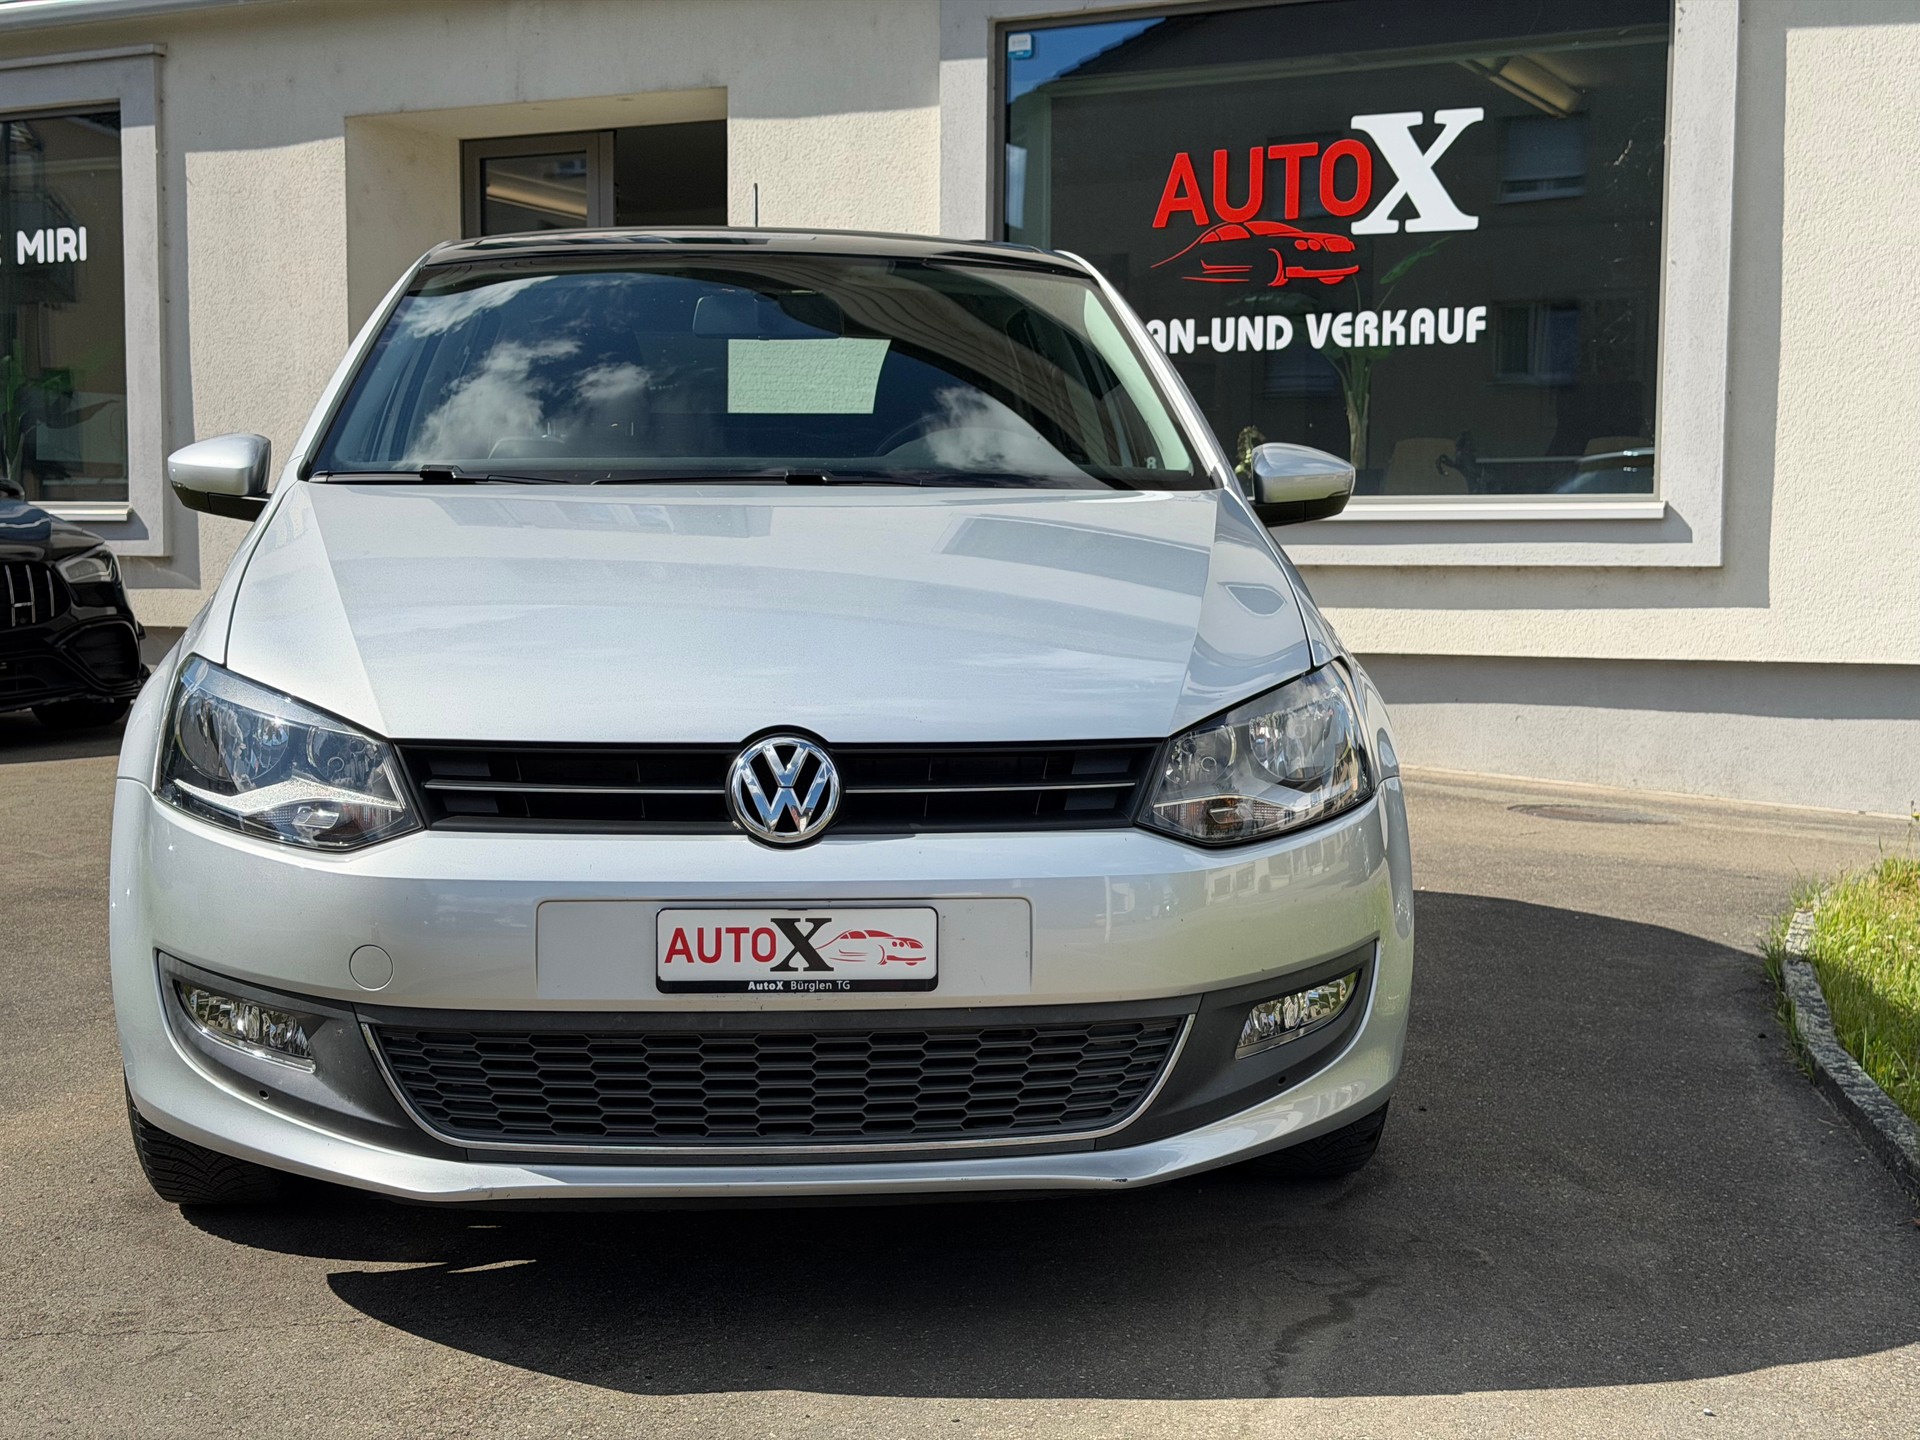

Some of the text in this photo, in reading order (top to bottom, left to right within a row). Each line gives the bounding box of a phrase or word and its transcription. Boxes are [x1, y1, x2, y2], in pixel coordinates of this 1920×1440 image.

[16, 226, 87, 265] MIRI
[1146, 306, 1487, 355] AN-UND VERKAUF
[747, 980, 850, 992] AutoX Bürglen TG
